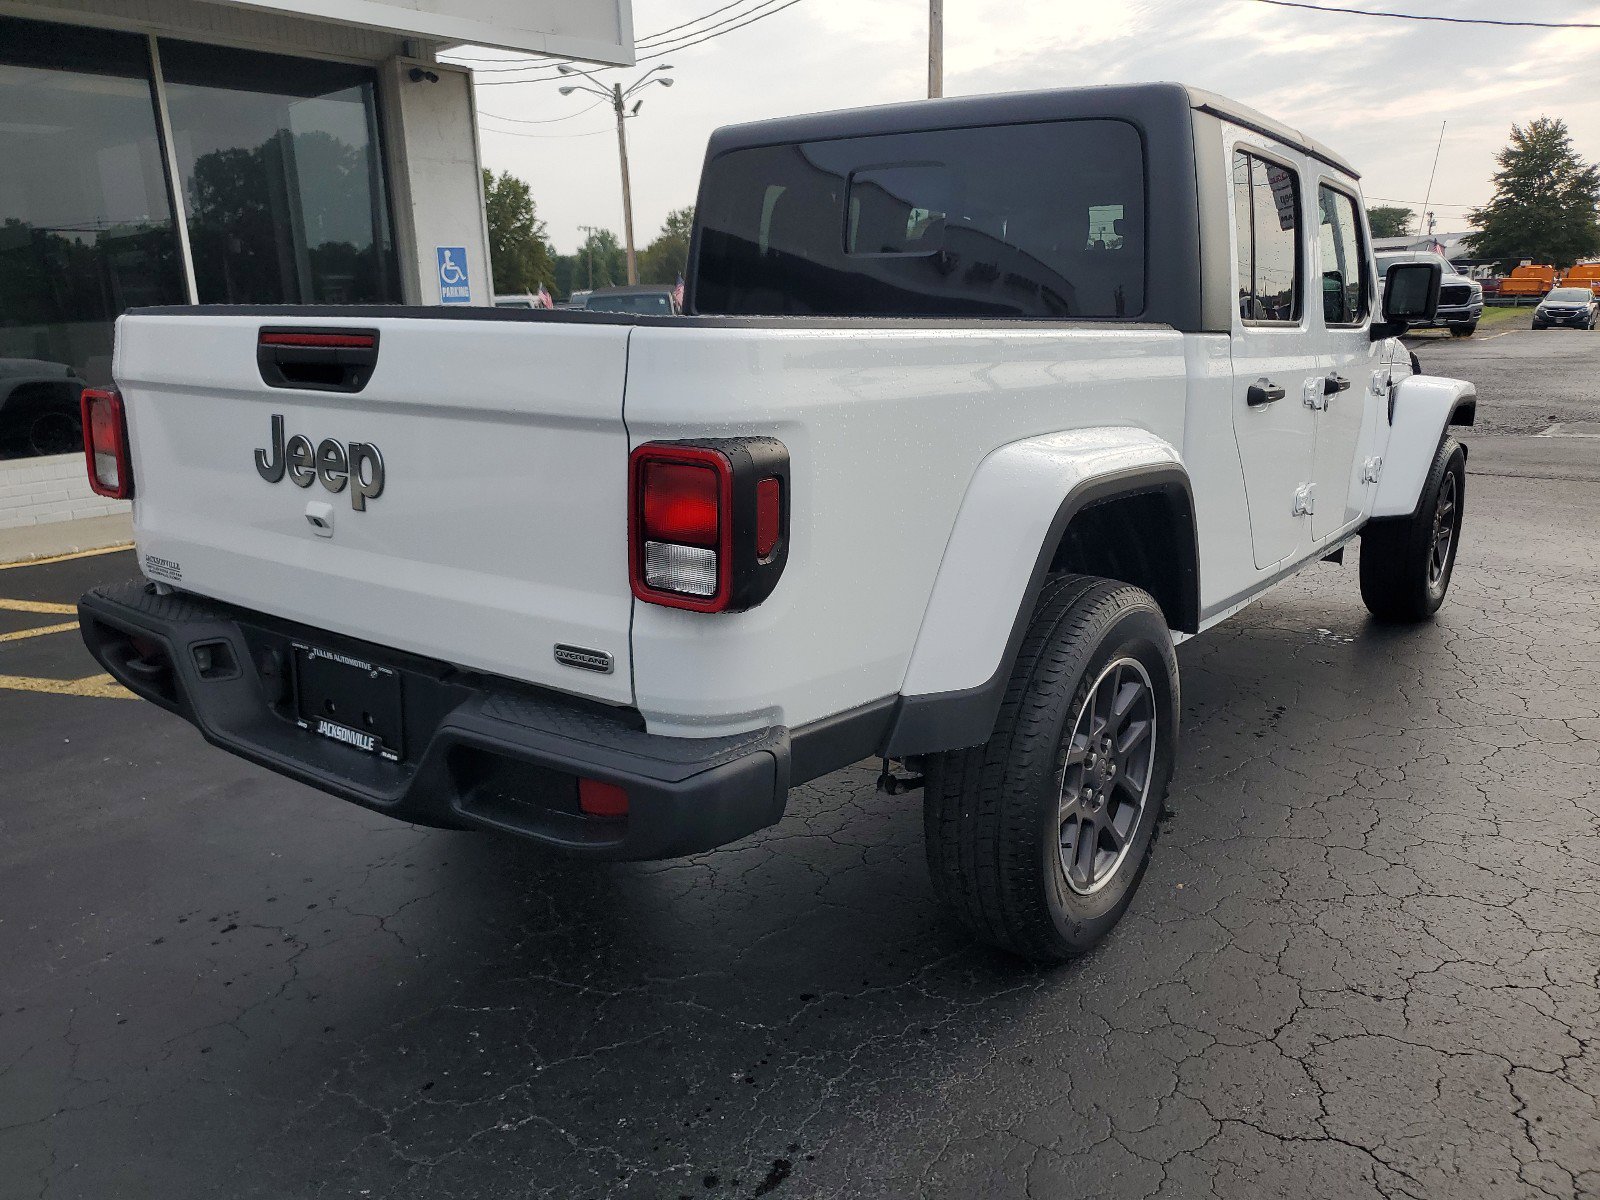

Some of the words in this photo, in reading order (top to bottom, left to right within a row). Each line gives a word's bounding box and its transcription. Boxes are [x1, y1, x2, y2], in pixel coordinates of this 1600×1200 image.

[442, 286, 470, 298] PARKING
[254, 413, 386, 511] Jeep
[333, 653, 373, 671] AUTOMOTIVE
[555, 650, 609, 666] OVERLAND
[317, 720, 375, 751] JACKSONVILLE
